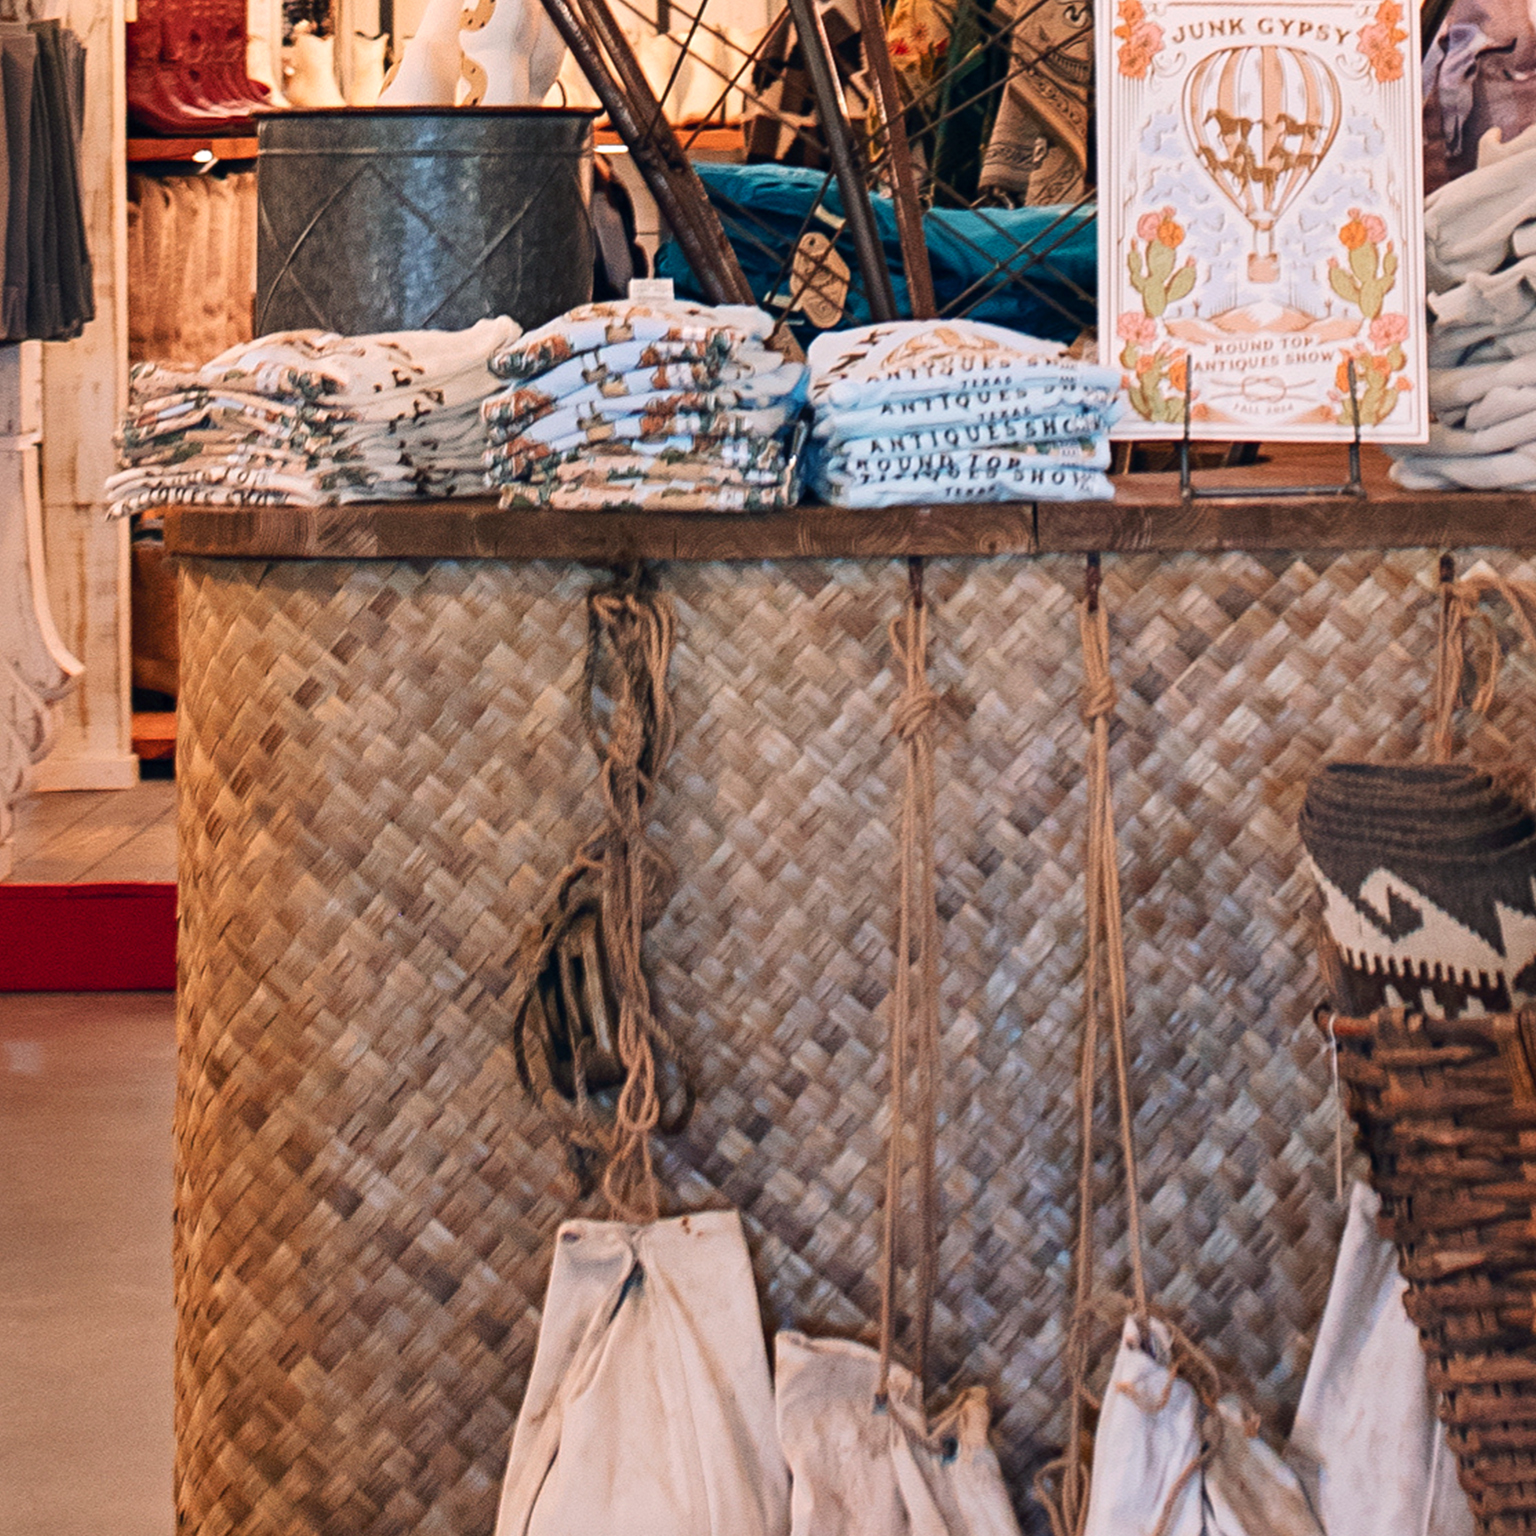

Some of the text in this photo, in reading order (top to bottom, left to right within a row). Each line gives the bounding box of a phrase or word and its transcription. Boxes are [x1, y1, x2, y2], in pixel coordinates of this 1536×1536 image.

[1171, 16, 1352, 46] JUNK GYPSY
[1214, 336, 1313, 355] ROUND TOP
[1193, 350, 1337, 373] ANTIQUES SHOW
